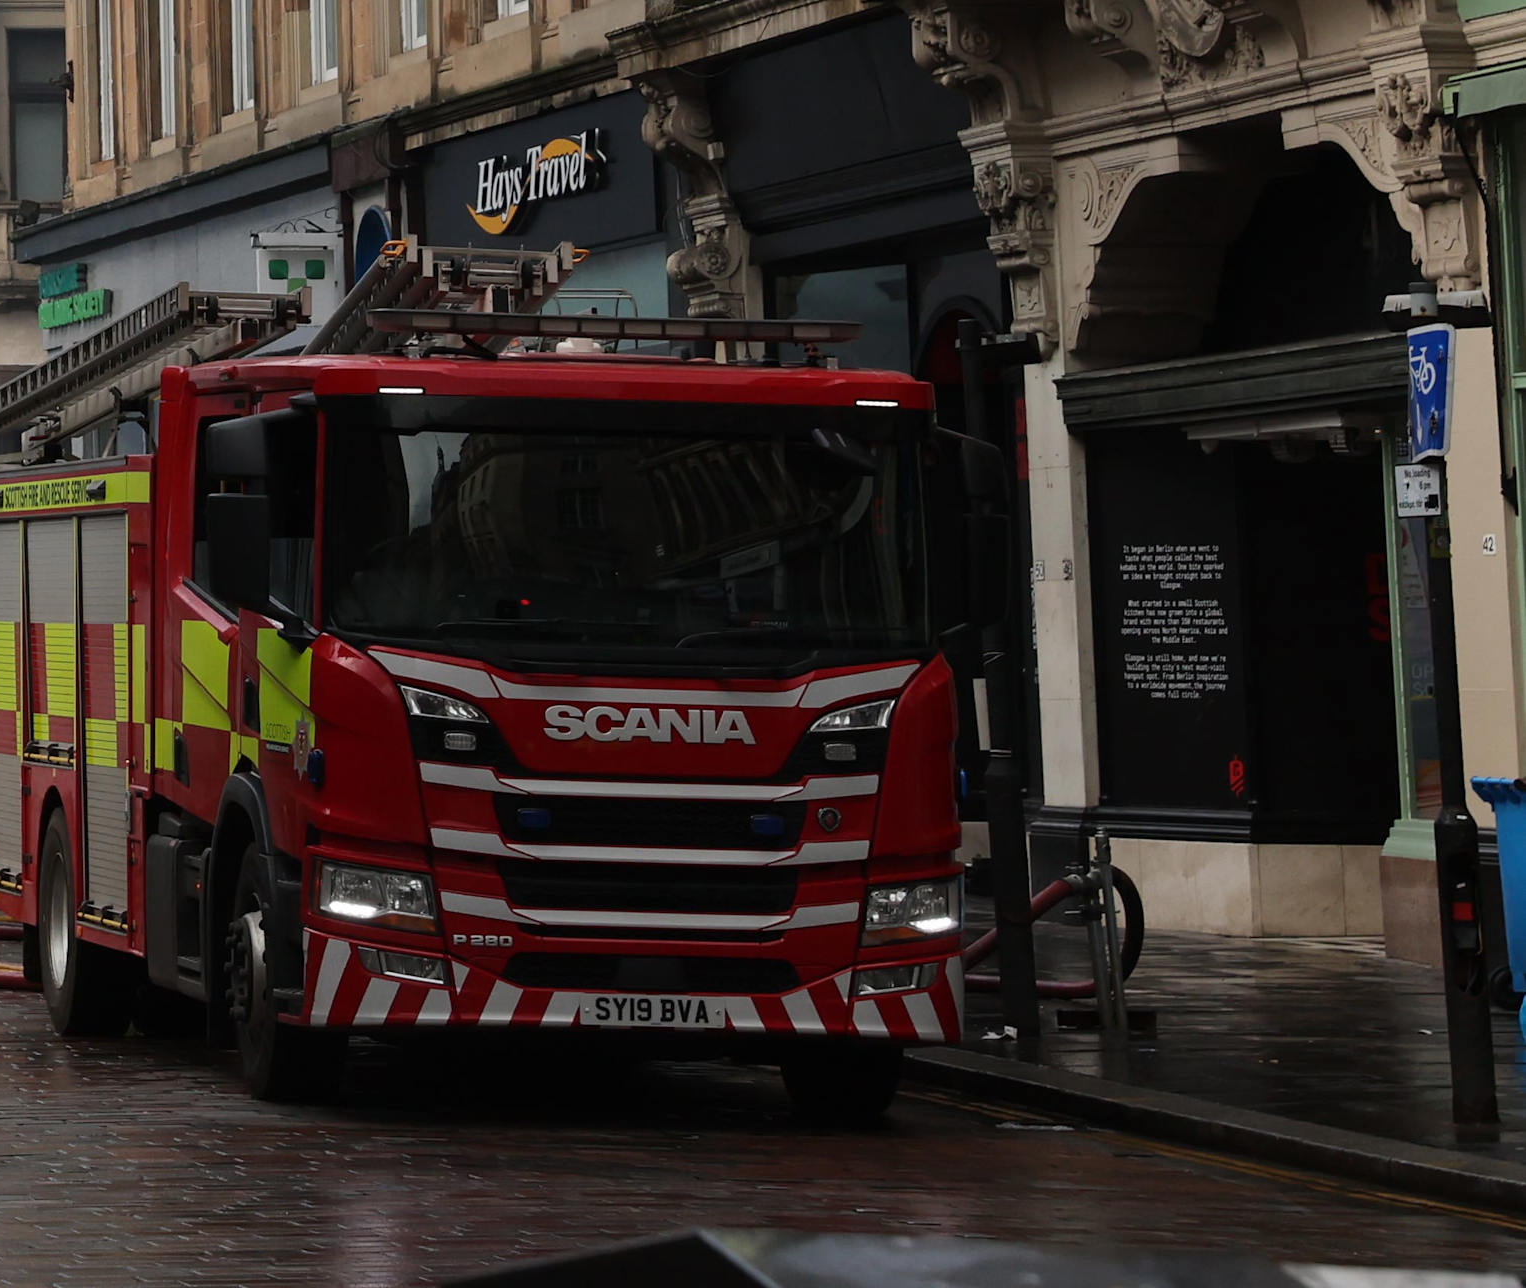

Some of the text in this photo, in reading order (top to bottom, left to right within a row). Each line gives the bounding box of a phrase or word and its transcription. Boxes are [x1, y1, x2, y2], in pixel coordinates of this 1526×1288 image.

[475, 130, 588, 223] Hays Travel
[1413, 468, 1431, 480] loading
[29, 484, 39, 507] FIRE
[40, 483, 50, 506] AND
[51, 481, 70, 505] RESCUE
[1483, 537, 1494, 552] 42
[544, 704, 756, 745] SCANIA
[453, 934, 514, 947] P 280
[595, 997, 709, 1024] SY19 BVA
